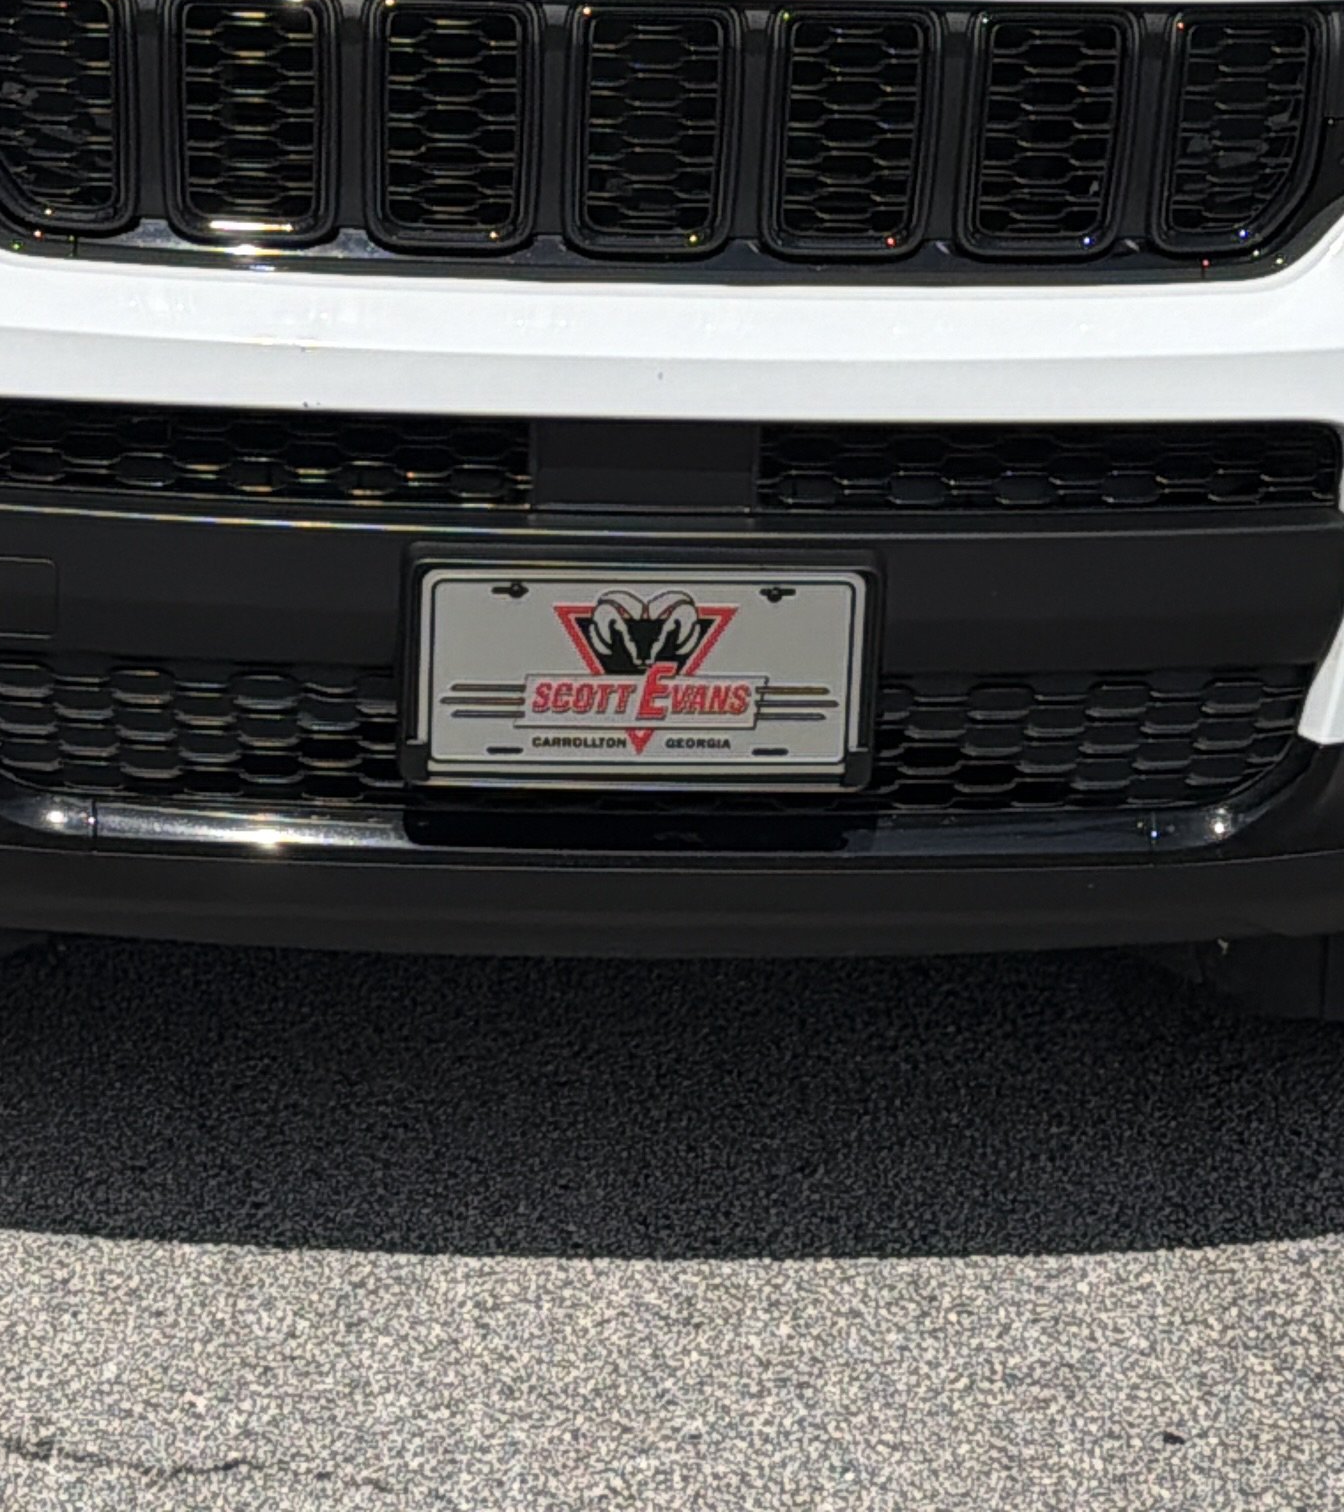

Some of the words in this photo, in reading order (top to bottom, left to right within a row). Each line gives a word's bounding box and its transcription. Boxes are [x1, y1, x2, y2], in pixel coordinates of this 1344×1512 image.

[531, 681, 638, 716] SCOTT
[634, 660, 753, 722] EVANS
[531, 736, 627, 750] CARROLLTON
[665, 737, 732, 751] GEORGIA
